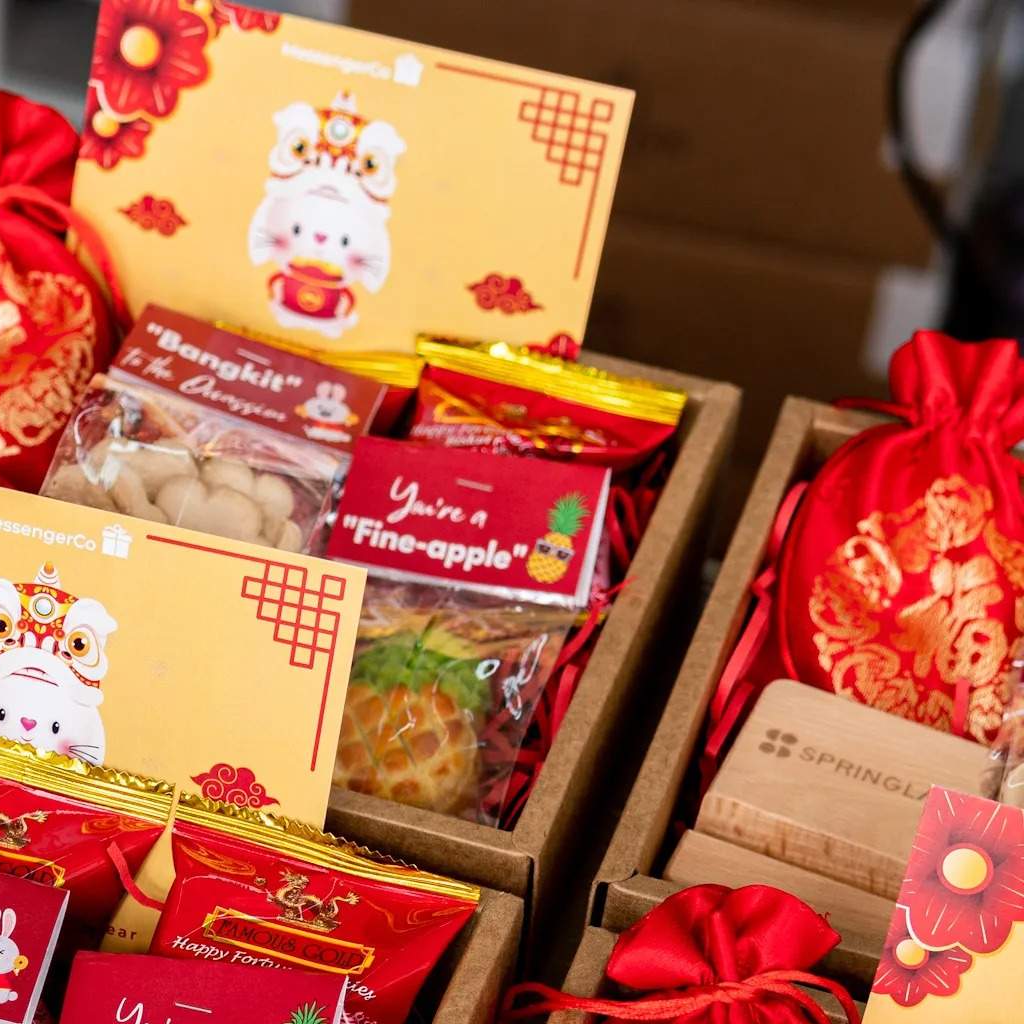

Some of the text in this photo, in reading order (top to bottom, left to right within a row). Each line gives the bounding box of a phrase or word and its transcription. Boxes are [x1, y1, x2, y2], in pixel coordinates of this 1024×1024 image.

[799, 746, 931, 801] SPRINGL
[106, 925, 137, 941] ear
[172, 935, 292, 970] Happy Fortu
